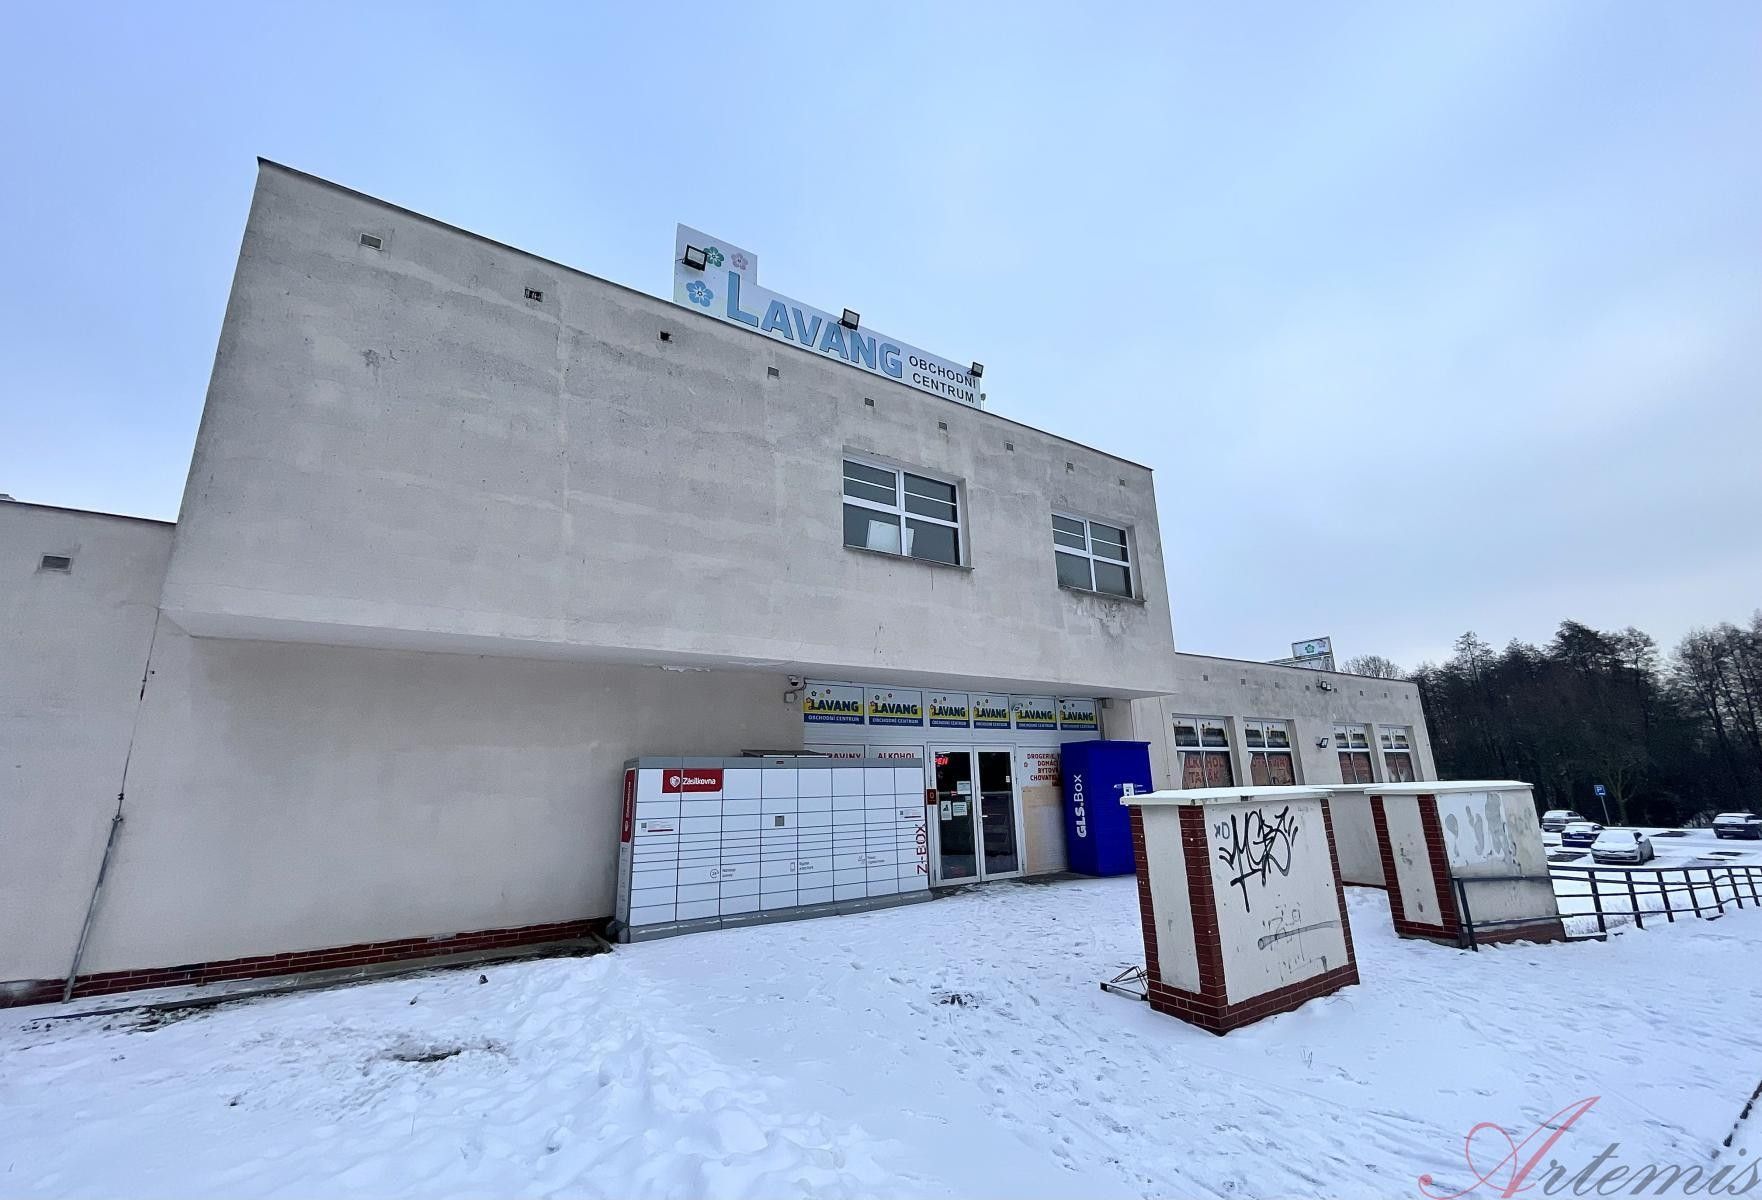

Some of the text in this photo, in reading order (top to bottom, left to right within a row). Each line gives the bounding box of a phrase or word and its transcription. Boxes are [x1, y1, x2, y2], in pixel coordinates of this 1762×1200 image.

[727, 271, 903, 379] LAVANG
[912, 372, 974, 403] CENTRUM
[808, 699, 859, 712] LAVANG
[873, 702, 918, 714] LAVANG
[933, 705, 966, 717] LAVANG
[976, 707, 1007, 718] LAVANG
[1020, 709, 1053, 720] LAVANG
[1063, 711, 1094, 721] LAVANG
[682, 777, 716, 785] Zásilkovna
